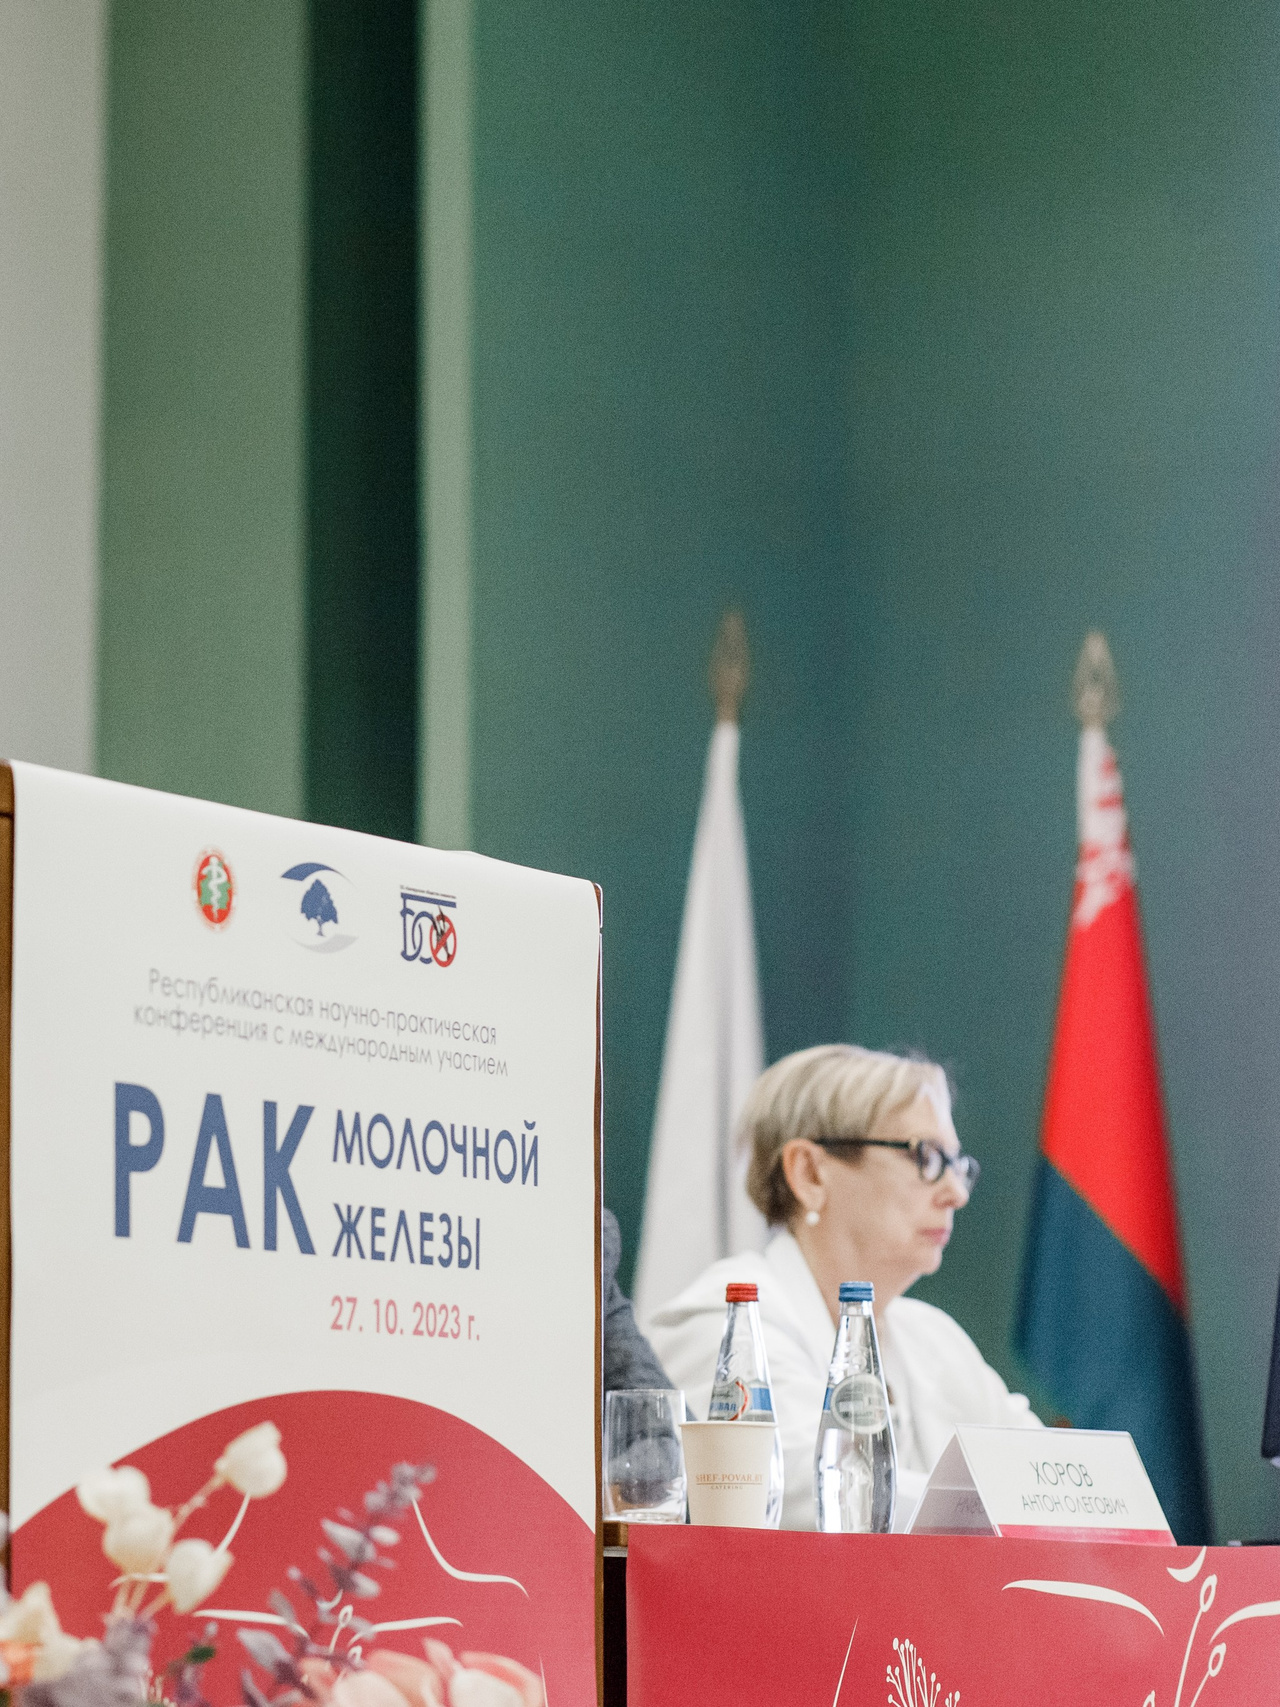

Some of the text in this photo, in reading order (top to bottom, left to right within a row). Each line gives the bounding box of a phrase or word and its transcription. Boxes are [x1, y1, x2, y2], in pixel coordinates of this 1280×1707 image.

[133, 1003, 509, 1077] конференция с международным участием
[148, 968, 497, 1046] Республиканская научно-практическая
[114, 1081, 317, 1256] РАК
[332, 1109, 539, 1187] МОЛОЧНОЙ
[331, 1203, 481, 1271] ЖЕЛЕЗЫ
[412, 1301, 461, 1339] 2023
[468, 1315, 480, 1341] г.
[1022, 1494, 1129, 1515] АНТОН ОЛЕГОВИЧ
[1029, 1461, 1093, 1487] ХОРОВ
